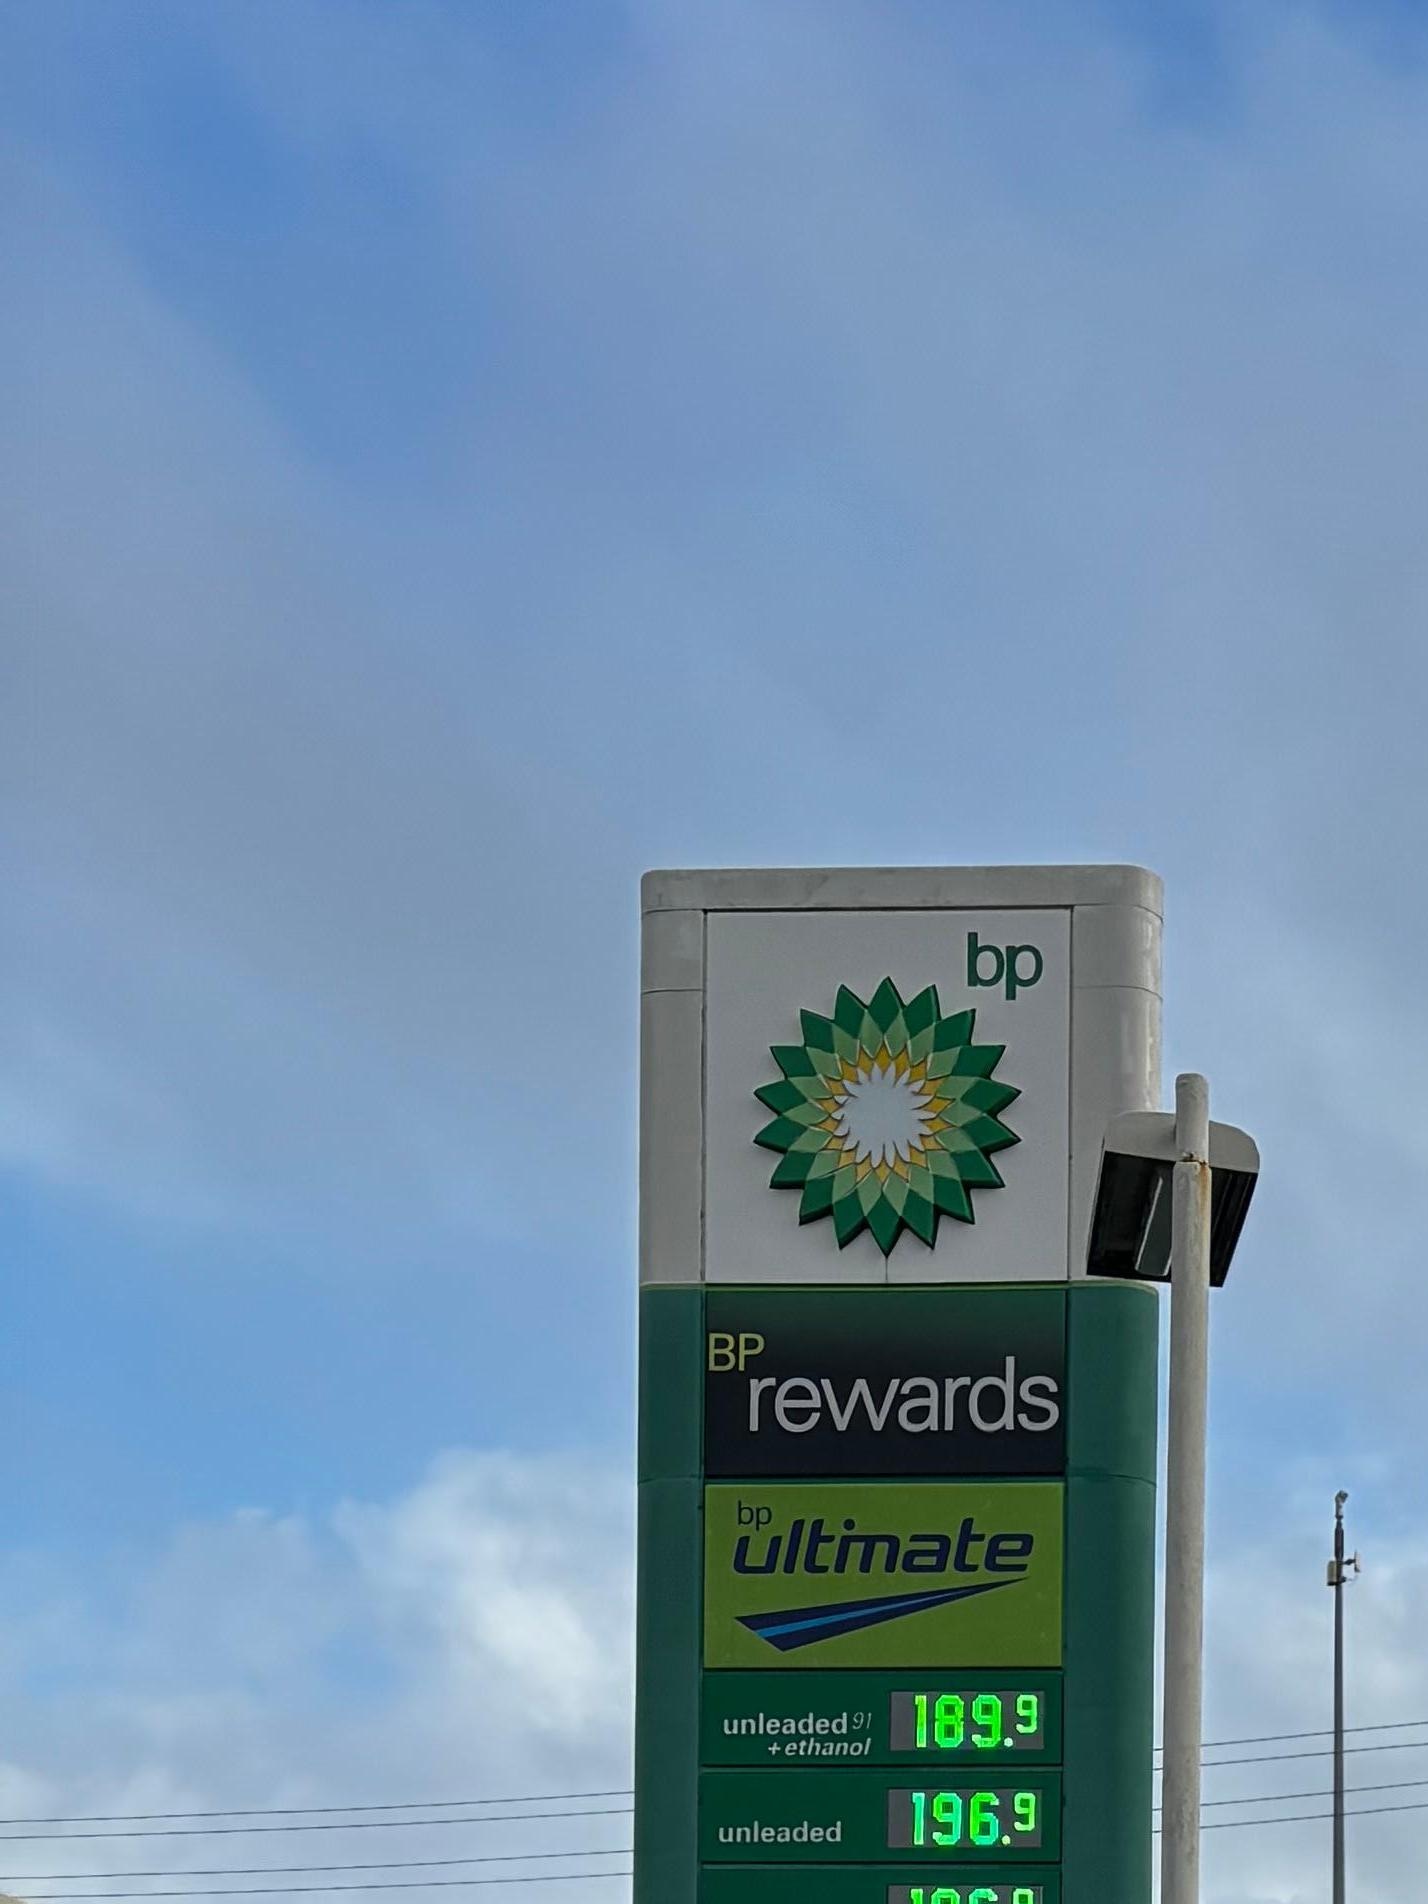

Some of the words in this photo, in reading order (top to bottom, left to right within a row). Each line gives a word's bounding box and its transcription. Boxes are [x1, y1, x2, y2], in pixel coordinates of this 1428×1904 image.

[967, 932, 1042, 999] bp
[708, 1333, 764, 1372] BP
[749, 1356, 1059, 1432] rewards
[737, 1500, 772, 1530] bp
[733, 1517, 1034, 1575] ultimate
[723, 1714, 848, 1735] unleaded
[719, 1821, 842, 1844] unleaded
[912, 1791, 1036, 1846] 196.9
